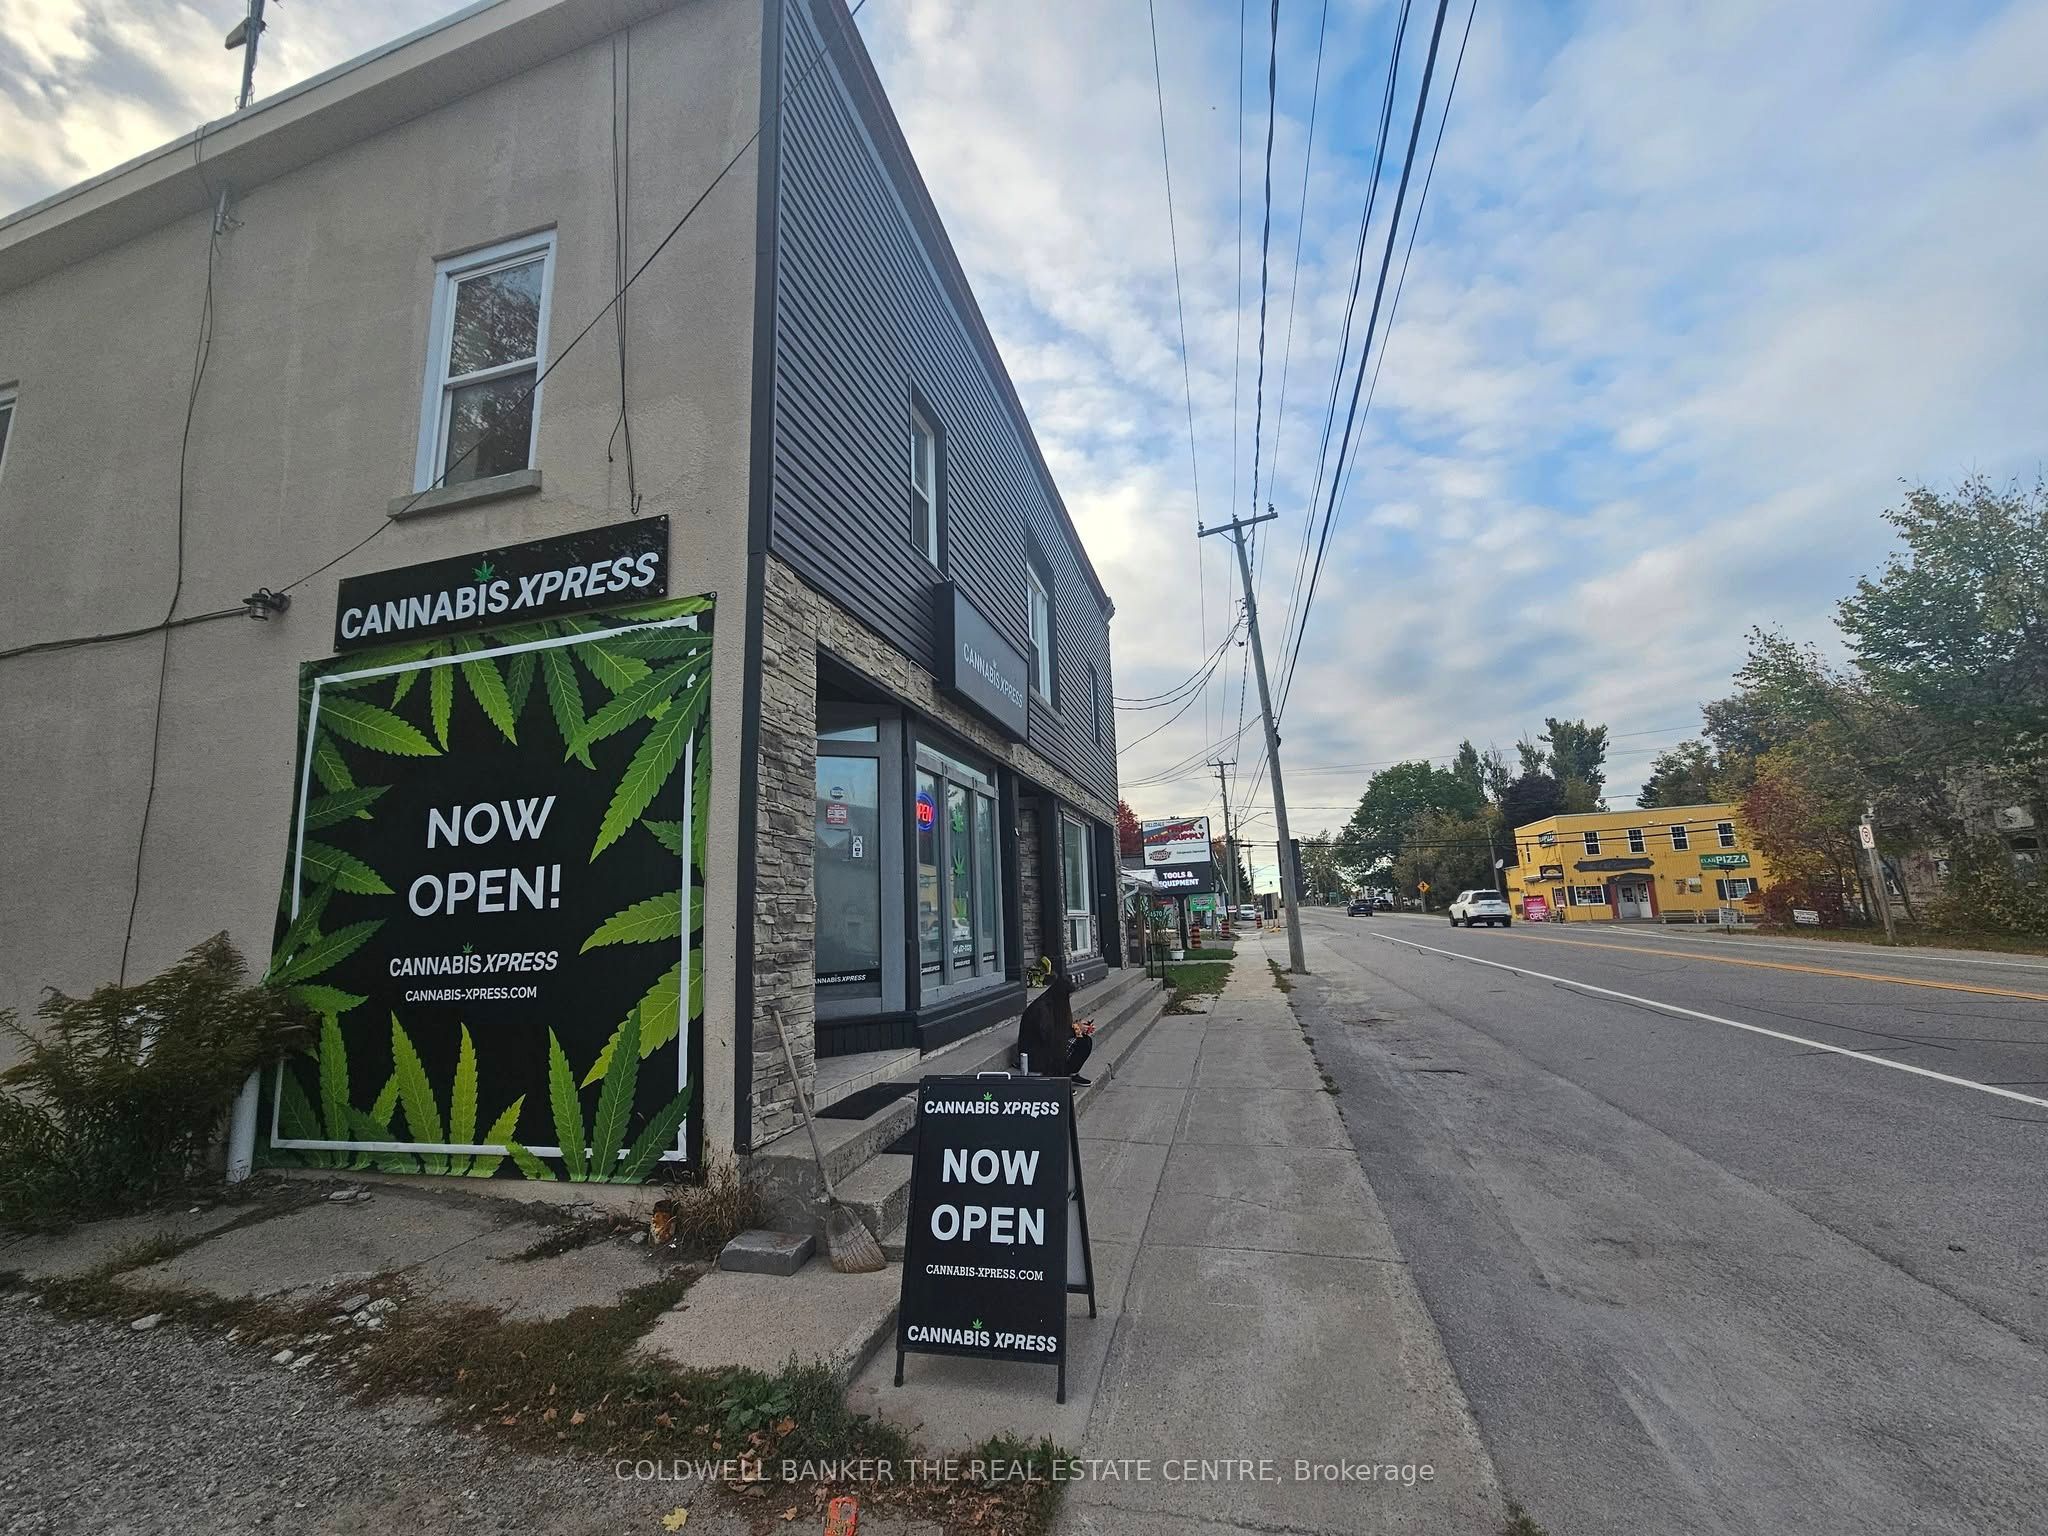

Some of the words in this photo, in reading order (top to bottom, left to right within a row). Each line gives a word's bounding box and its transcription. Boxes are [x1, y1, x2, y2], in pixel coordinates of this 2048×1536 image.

[340, 580, 510, 639] CANNABIS
[511, 551, 659, 610] XPRESS
[963, 642, 1001, 690] CANNABIS
[999, 676, 1024, 708] XPRESS
[427, 795, 556, 849] NOW
[1716, 854, 1749, 864] PIZZA
[408, 863, 561, 917] OPEN!
[389, 954, 482, 977] CANNABIS
[482, 950, 559, 972] XPRESS
[815, 976, 842, 985] ANNABIS
[841, 974, 867, 982] XPRESS
[405, 986, 537, 1002] CANNABIS-XPRESS.COM
[924, 1100, 999, 1115] CANNABIS
[1001, 1101, 1060, 1117] XPRESS
[942, 1148, 1040, 1185] NOW
[930, 1204, 1045, 1246] OPEN
[926, 1264, 1044, 1281] CANNABIS-XPRESS.COM
[907, 1325, 990, 1347] CANNABIS
[993, 1332, 1057, 1353] XPRESS
